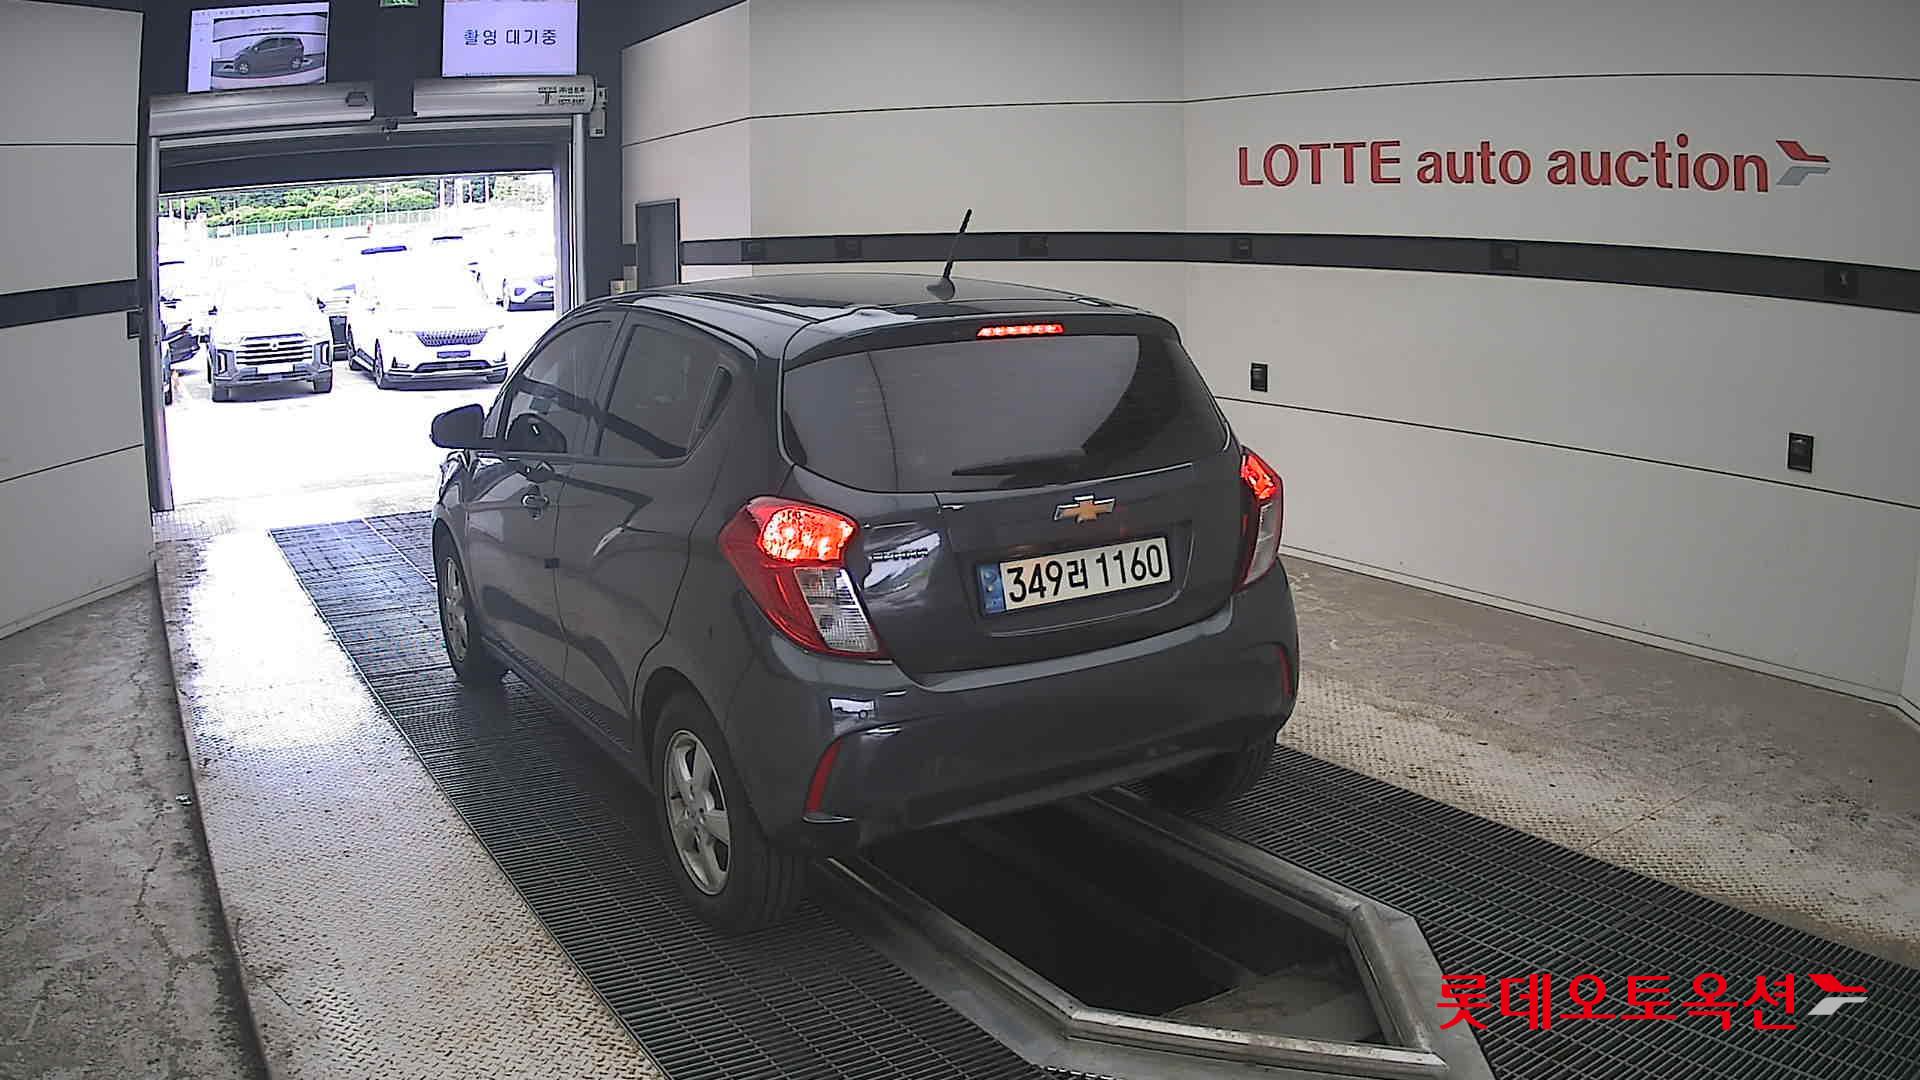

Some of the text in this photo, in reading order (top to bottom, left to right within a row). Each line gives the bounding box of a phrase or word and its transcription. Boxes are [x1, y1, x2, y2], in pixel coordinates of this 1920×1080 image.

[464, 29, 557, 46] 촬영 대기중
[1239, 132, 1769, 193] LOTTE auto auction
[1096, 544, 1164, 587] 1160
